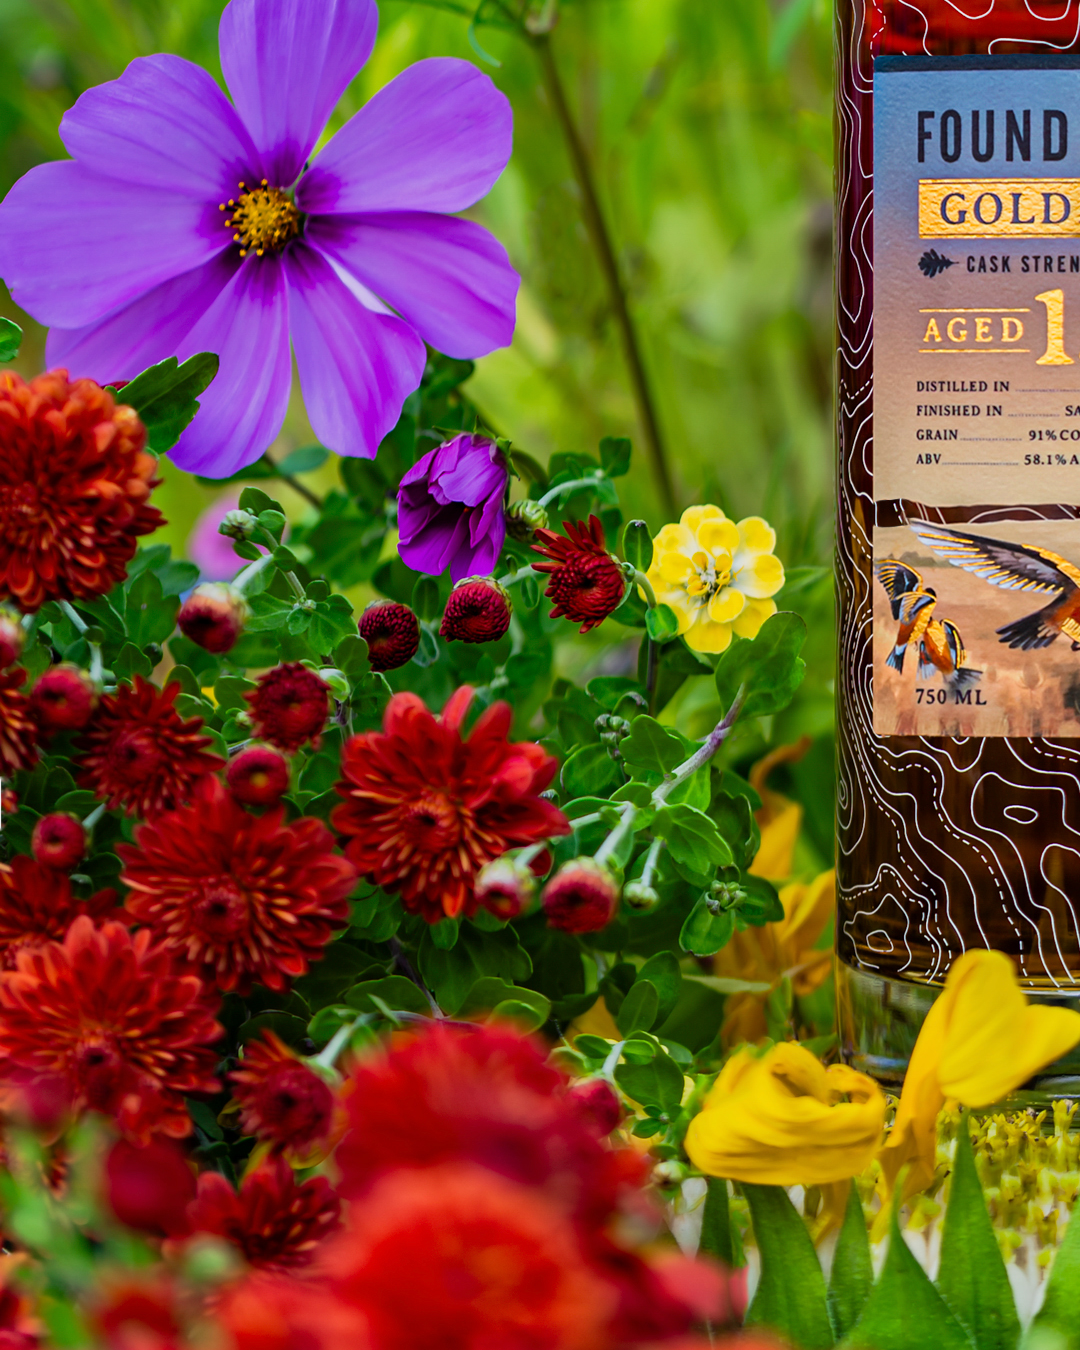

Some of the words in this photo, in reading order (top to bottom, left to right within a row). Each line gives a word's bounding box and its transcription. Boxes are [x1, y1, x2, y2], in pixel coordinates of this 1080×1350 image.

[918, 109, 1068, 163] FOUND
[967, 255, 1011, 273] CASK
[923, 317, 1024, 343] AGED
[916, 381, 988, 392] DISTILLED
[994, 381, 1010, 392] IN
[916, 405, 981, 417] FINISHED
[986, 405, 1002, 416] IN
[916, 429, 958, 441] GRAIN
[916, 454, 942, 465] ABV
[916, 689, 947, 705] 750
[955, 690, 987, 706] ML
